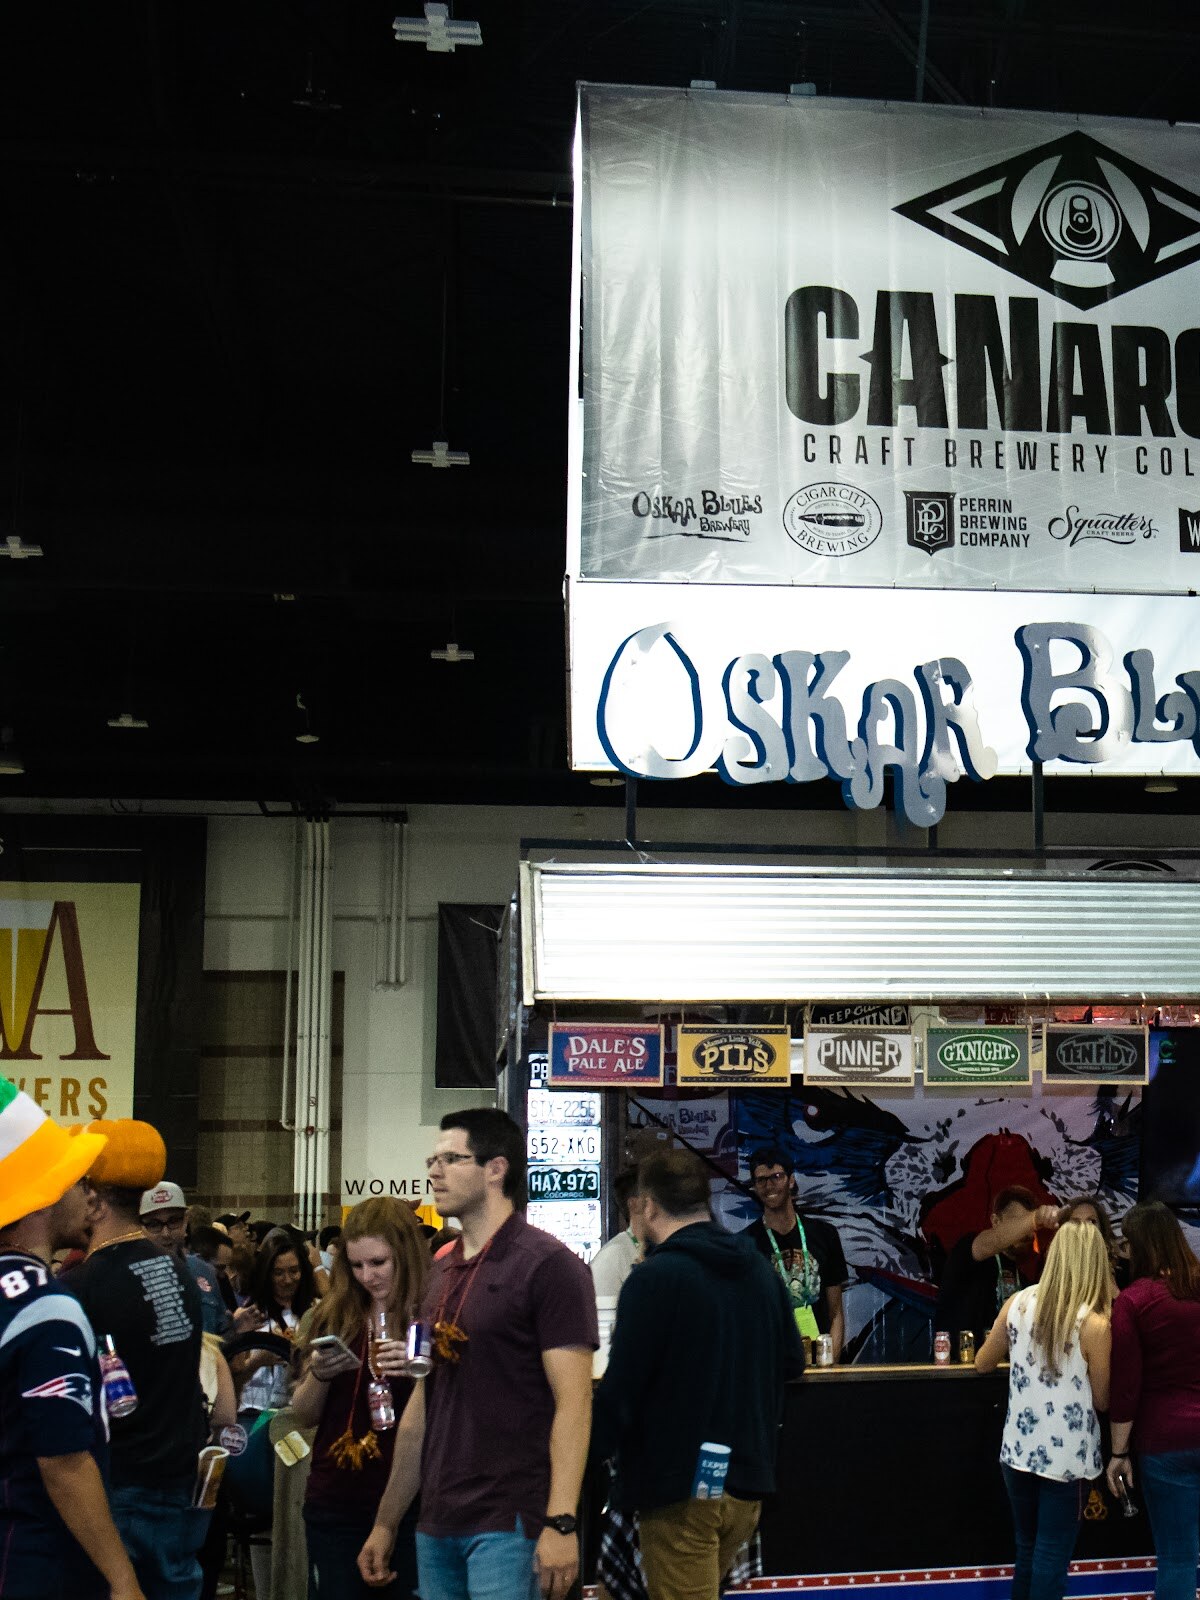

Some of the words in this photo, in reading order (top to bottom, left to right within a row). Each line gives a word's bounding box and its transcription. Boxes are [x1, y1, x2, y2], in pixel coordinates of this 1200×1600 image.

[803, 432, 916, 466] CRAFT
[945, 438, 1108, 474] BREWERY
[632, 491, 697, 527] OSKAR
[701, 489, 762, 515] BLUES
[796, 486, 836, 508] CIGAR
[838, 487, 870, 509] CITY
[960, 497, 1013, 514] PERRIN
[960, 514, 1028, 531] BREWING
[1048, 505, 1159, 548] Squatters
[796, 531, 870, 552] BREWING
[960, 532, 1030, 549] COMPANY
[596, 621, 998, 828] OSKAR
[569, 1035, 646, 1056] DALE'S
[820, 1039, 900, 1066] PINNER
[568, 1057, 606, 1072] PALE
[613, 1058, 645, 1073] ALE
[700, 1043, 769, 1073] PILS
[531, 1137, 559, 1155] S52
[567, 1136, 595, 1154] XKG
[544, 1191, 584, 1199] COLORADO
[0, 1264, 48, 1299] 87
